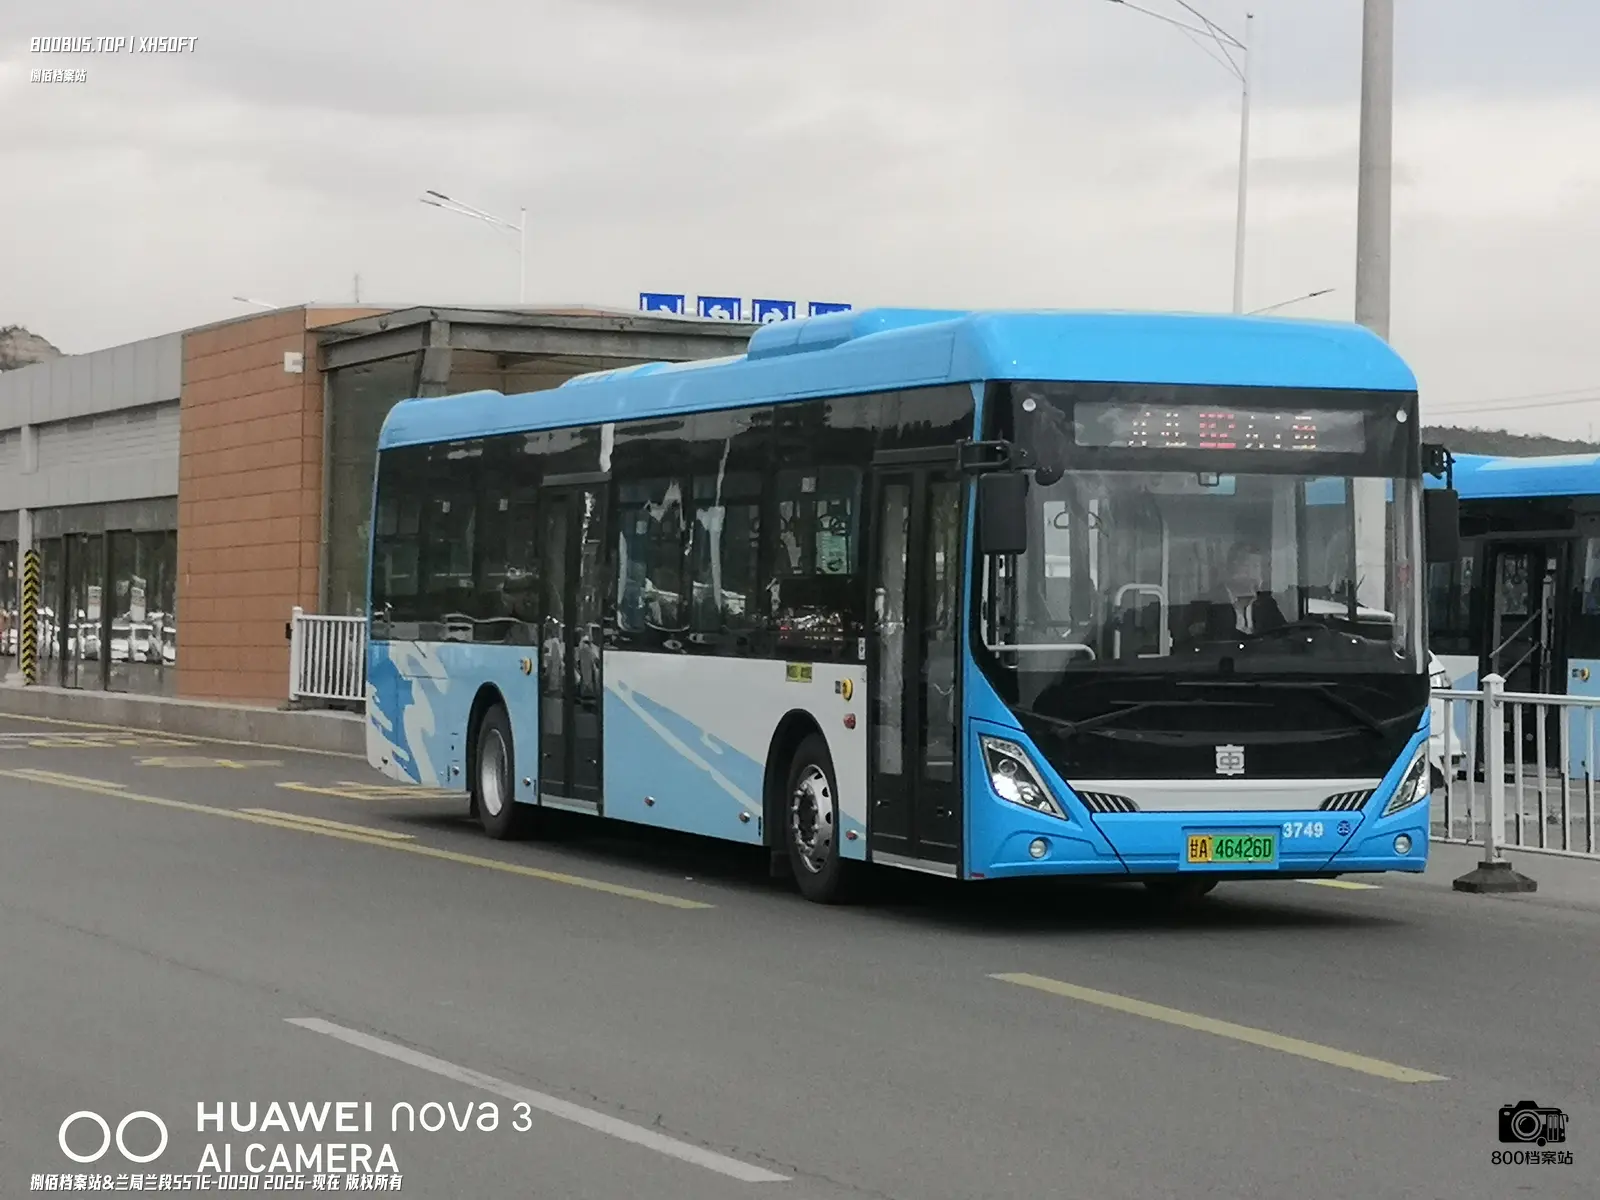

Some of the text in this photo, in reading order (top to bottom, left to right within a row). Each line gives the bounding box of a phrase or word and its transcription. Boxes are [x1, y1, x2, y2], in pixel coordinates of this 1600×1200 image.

[1282, 821, 1324, 838] 3749
[1190, 838, 1272, 858] 甘A 46426D
